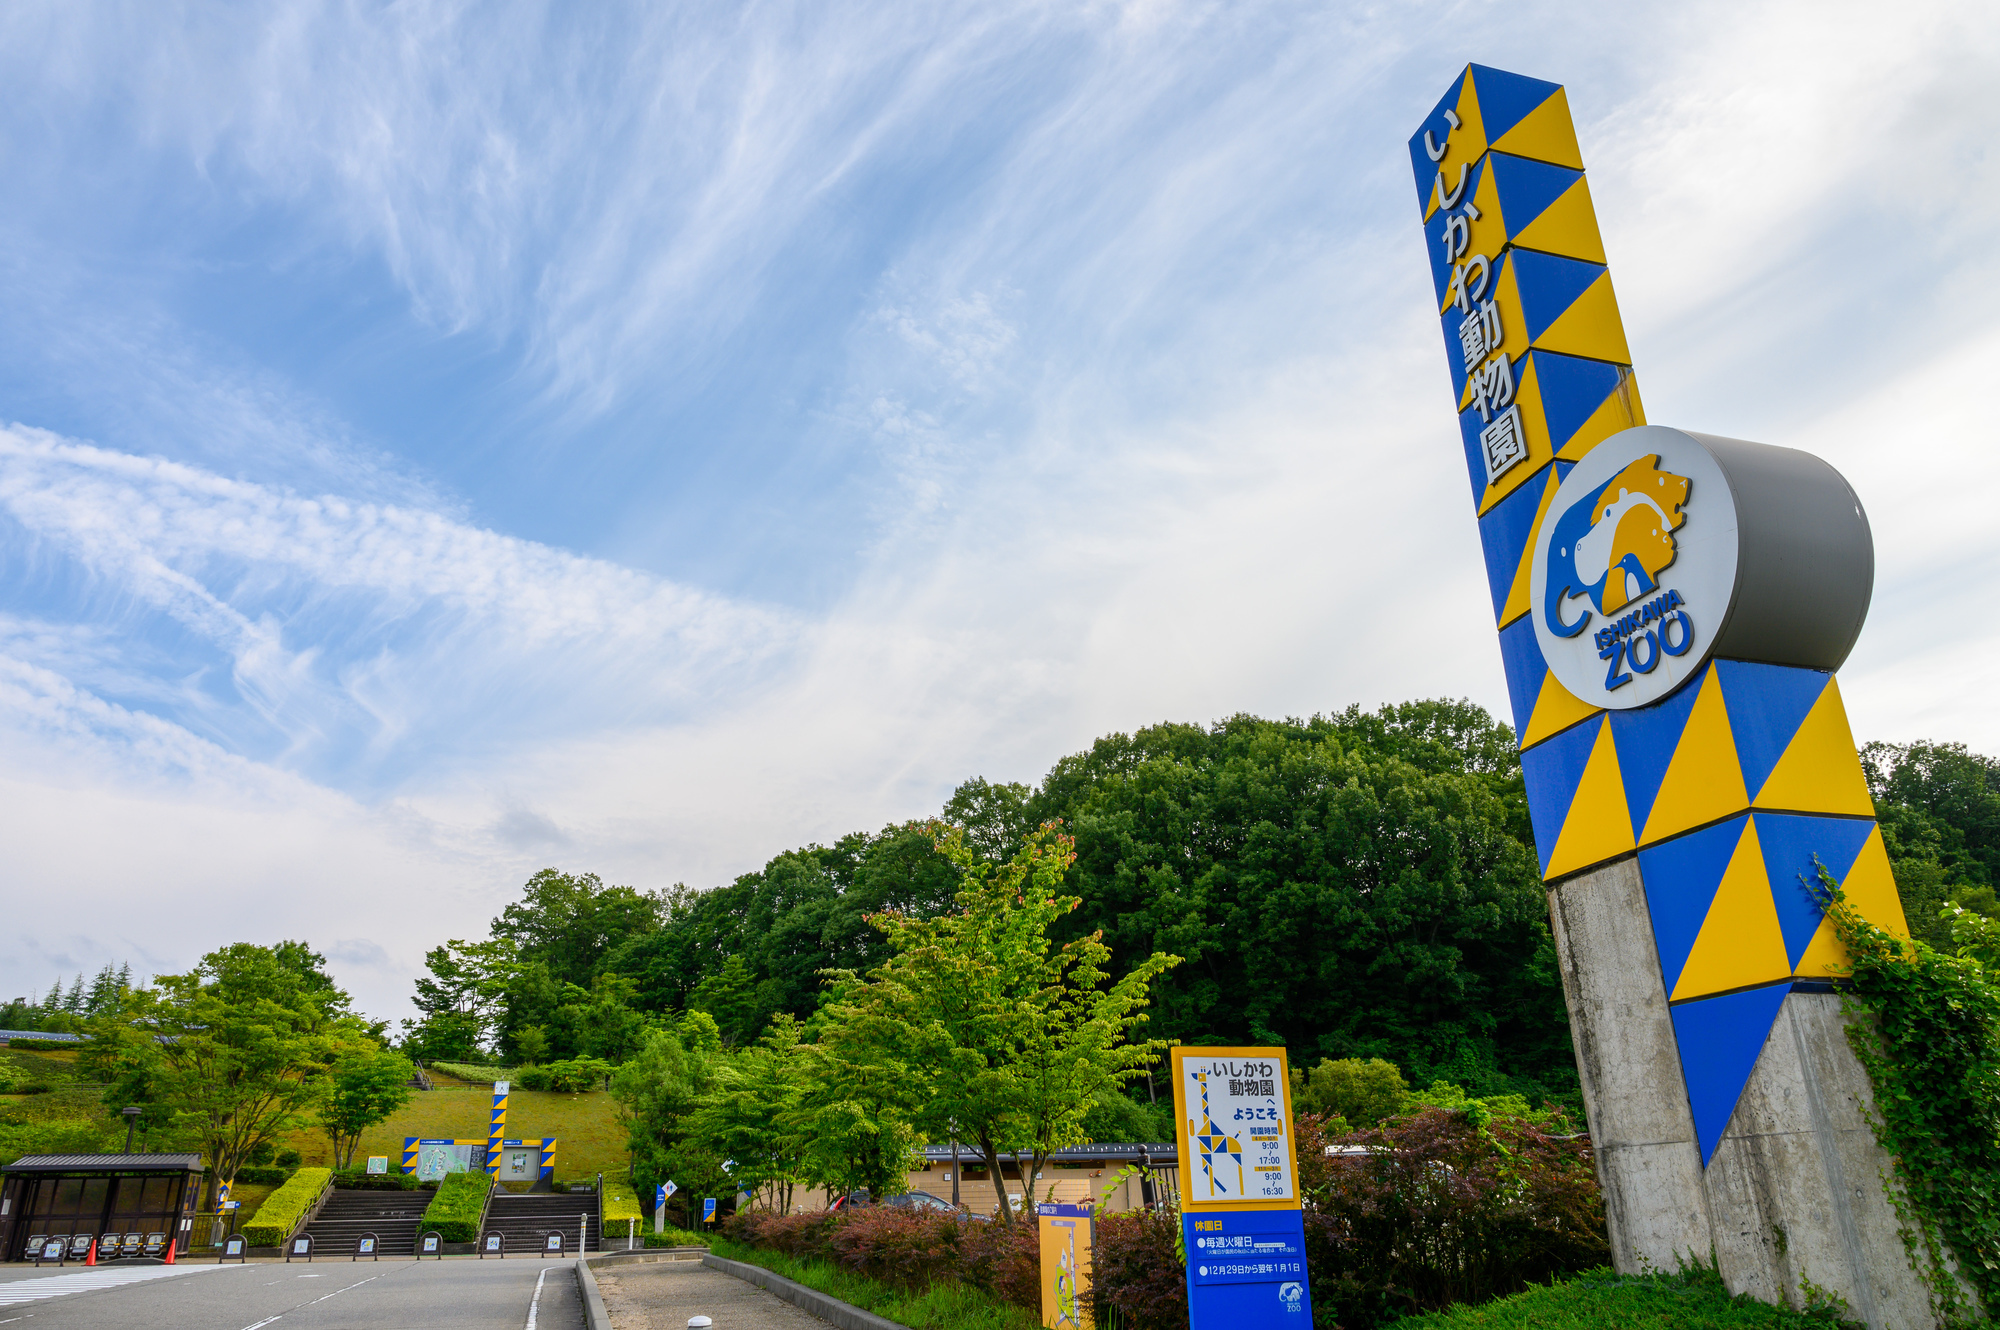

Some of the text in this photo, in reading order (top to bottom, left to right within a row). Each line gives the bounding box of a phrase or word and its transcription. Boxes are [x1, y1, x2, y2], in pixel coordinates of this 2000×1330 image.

[1424, 109, 1530, 485] いしかわ動物園
[1594, 589, 1685, 650] ISHIKAWA
[1598, 609, 1695, 691] ZOO
[1213, 1062, 1273, 1077] いしかわ
[1229, 1079, 1275, 1096] 動物園
[1233, 1108, 1278, 1121] ようこそ
[1262, 1187, 1283, 1195] 16:30
[1195, 1220, 1222, 1232] 休園日
